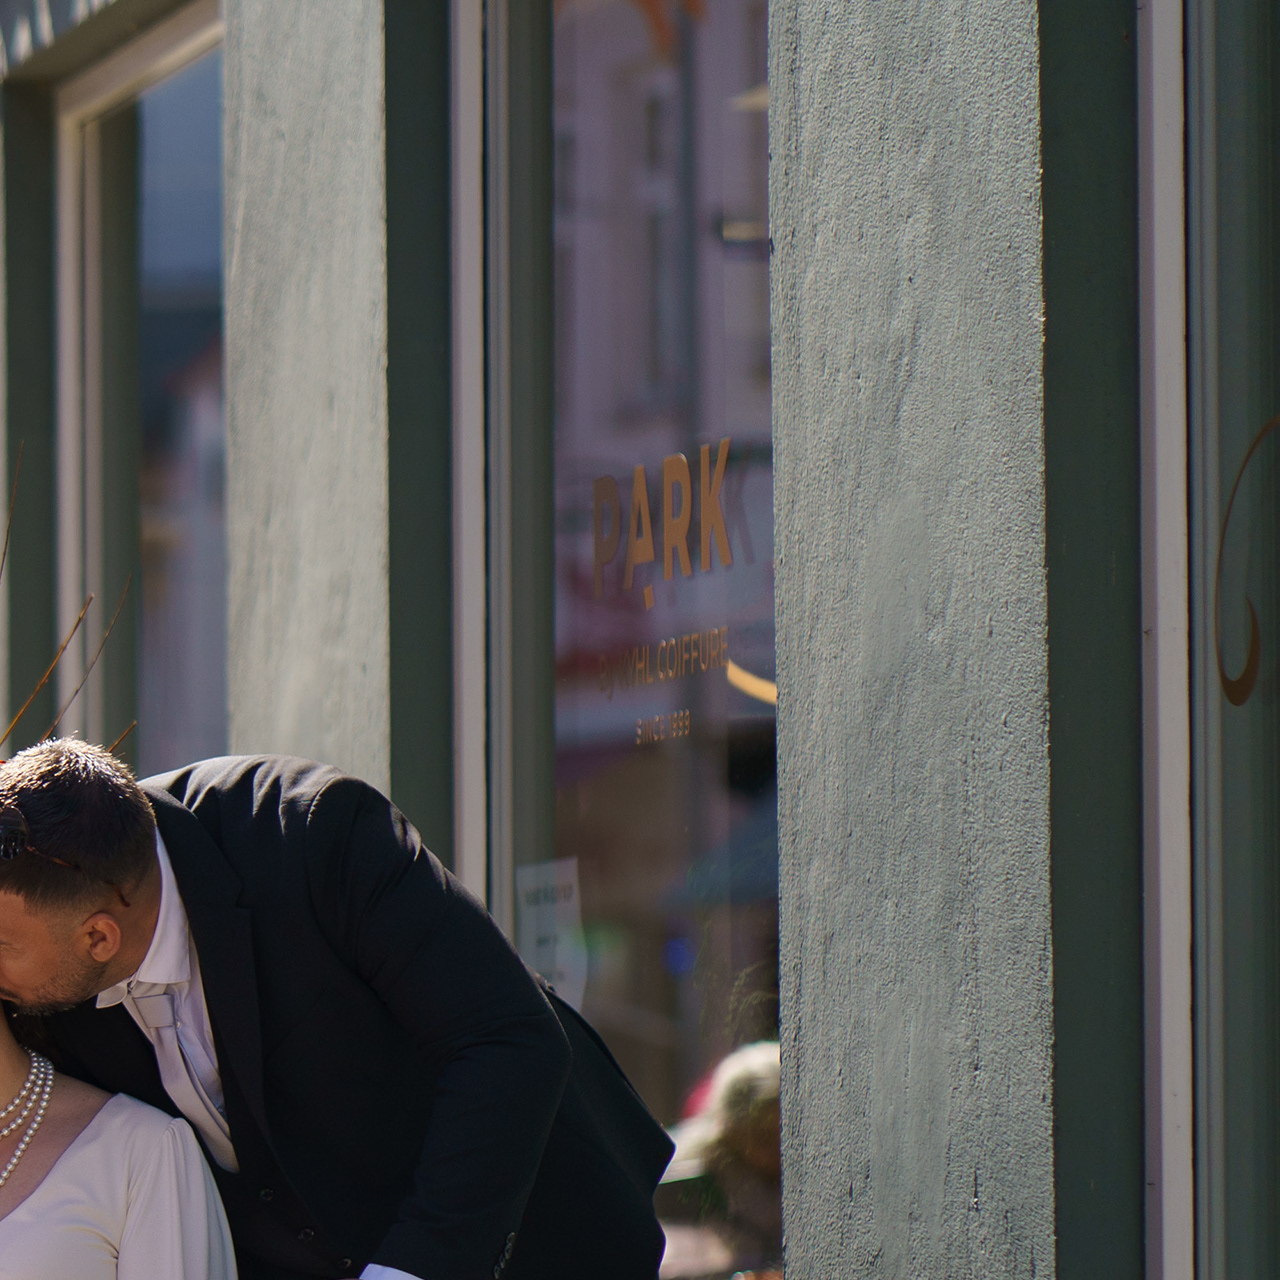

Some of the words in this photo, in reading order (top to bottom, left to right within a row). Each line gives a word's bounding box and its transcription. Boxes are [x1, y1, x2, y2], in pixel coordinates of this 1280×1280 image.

[592, 437, 733, 608] PARK
[656, 625, 729, 681] COIFFURE
[635, 714, 666, 745] SINCE
